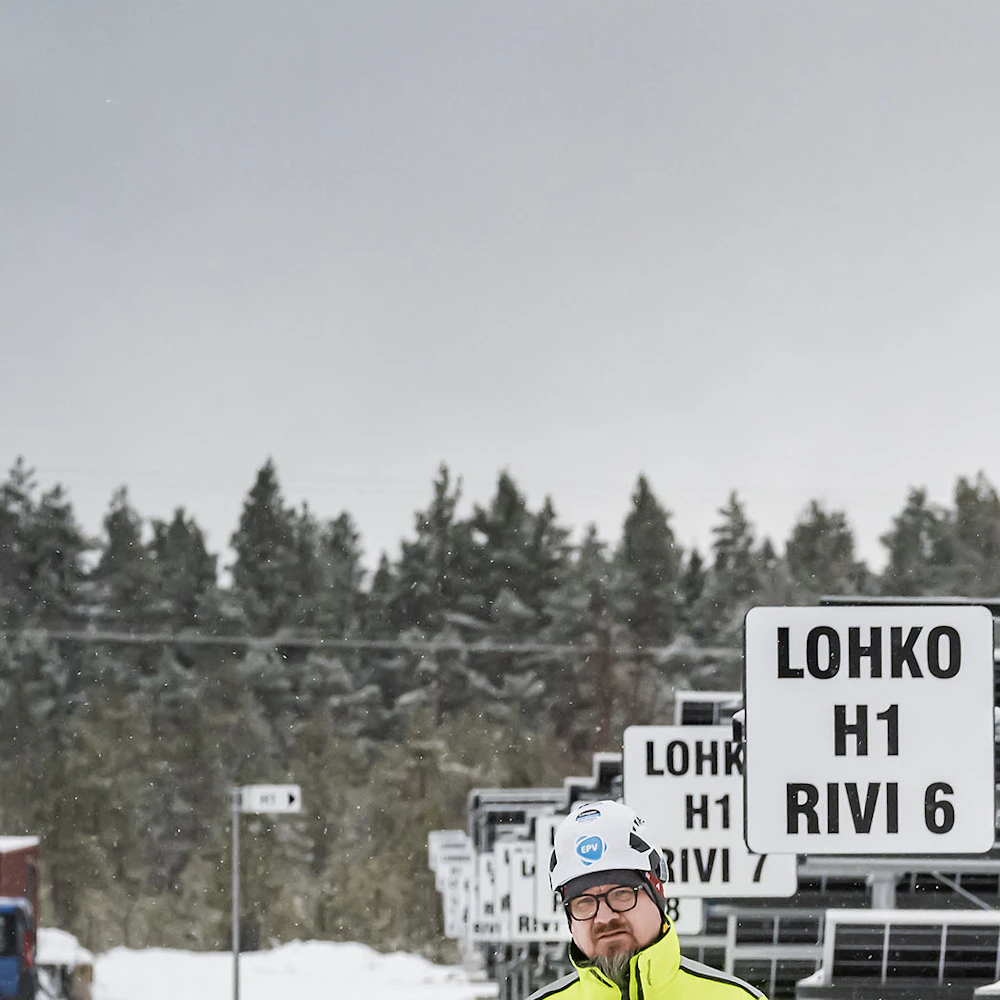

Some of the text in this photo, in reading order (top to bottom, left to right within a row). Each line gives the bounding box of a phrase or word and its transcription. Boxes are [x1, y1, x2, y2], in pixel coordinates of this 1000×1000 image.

[777, 625, 962, 680] LOHKO
[834, 704, 899, 757] H1
[646, 740, 743, 776] LOHK
[685, 794, 730, 829] H1
[786, 781, 955, 835] RIVI 6
[580, 843, 599, 854] EPV
[662, 848, 730, 883] RIVI
